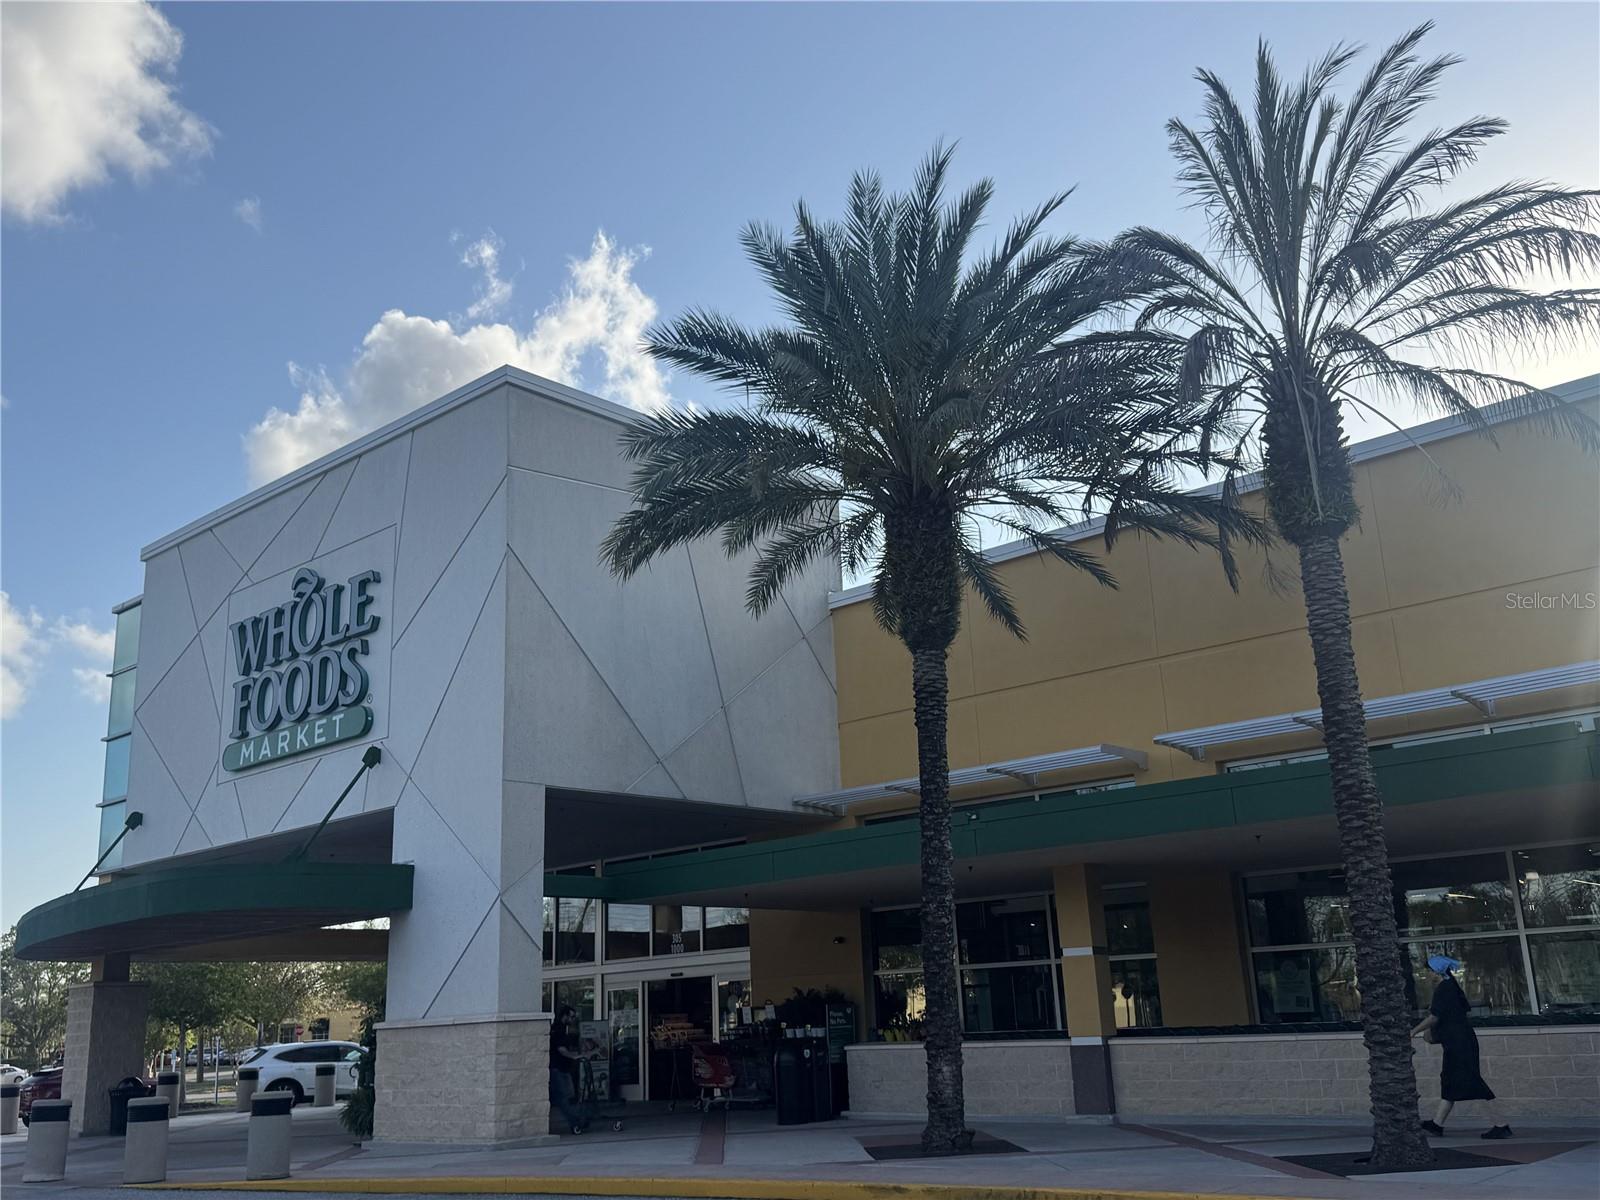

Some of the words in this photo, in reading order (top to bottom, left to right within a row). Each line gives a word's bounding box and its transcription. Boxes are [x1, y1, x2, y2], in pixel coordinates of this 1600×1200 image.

[229, 568, 381, 676] WHOLE
[229, 639, 369, 739] FOODS
[239, 713, 345, 766] MARKET
